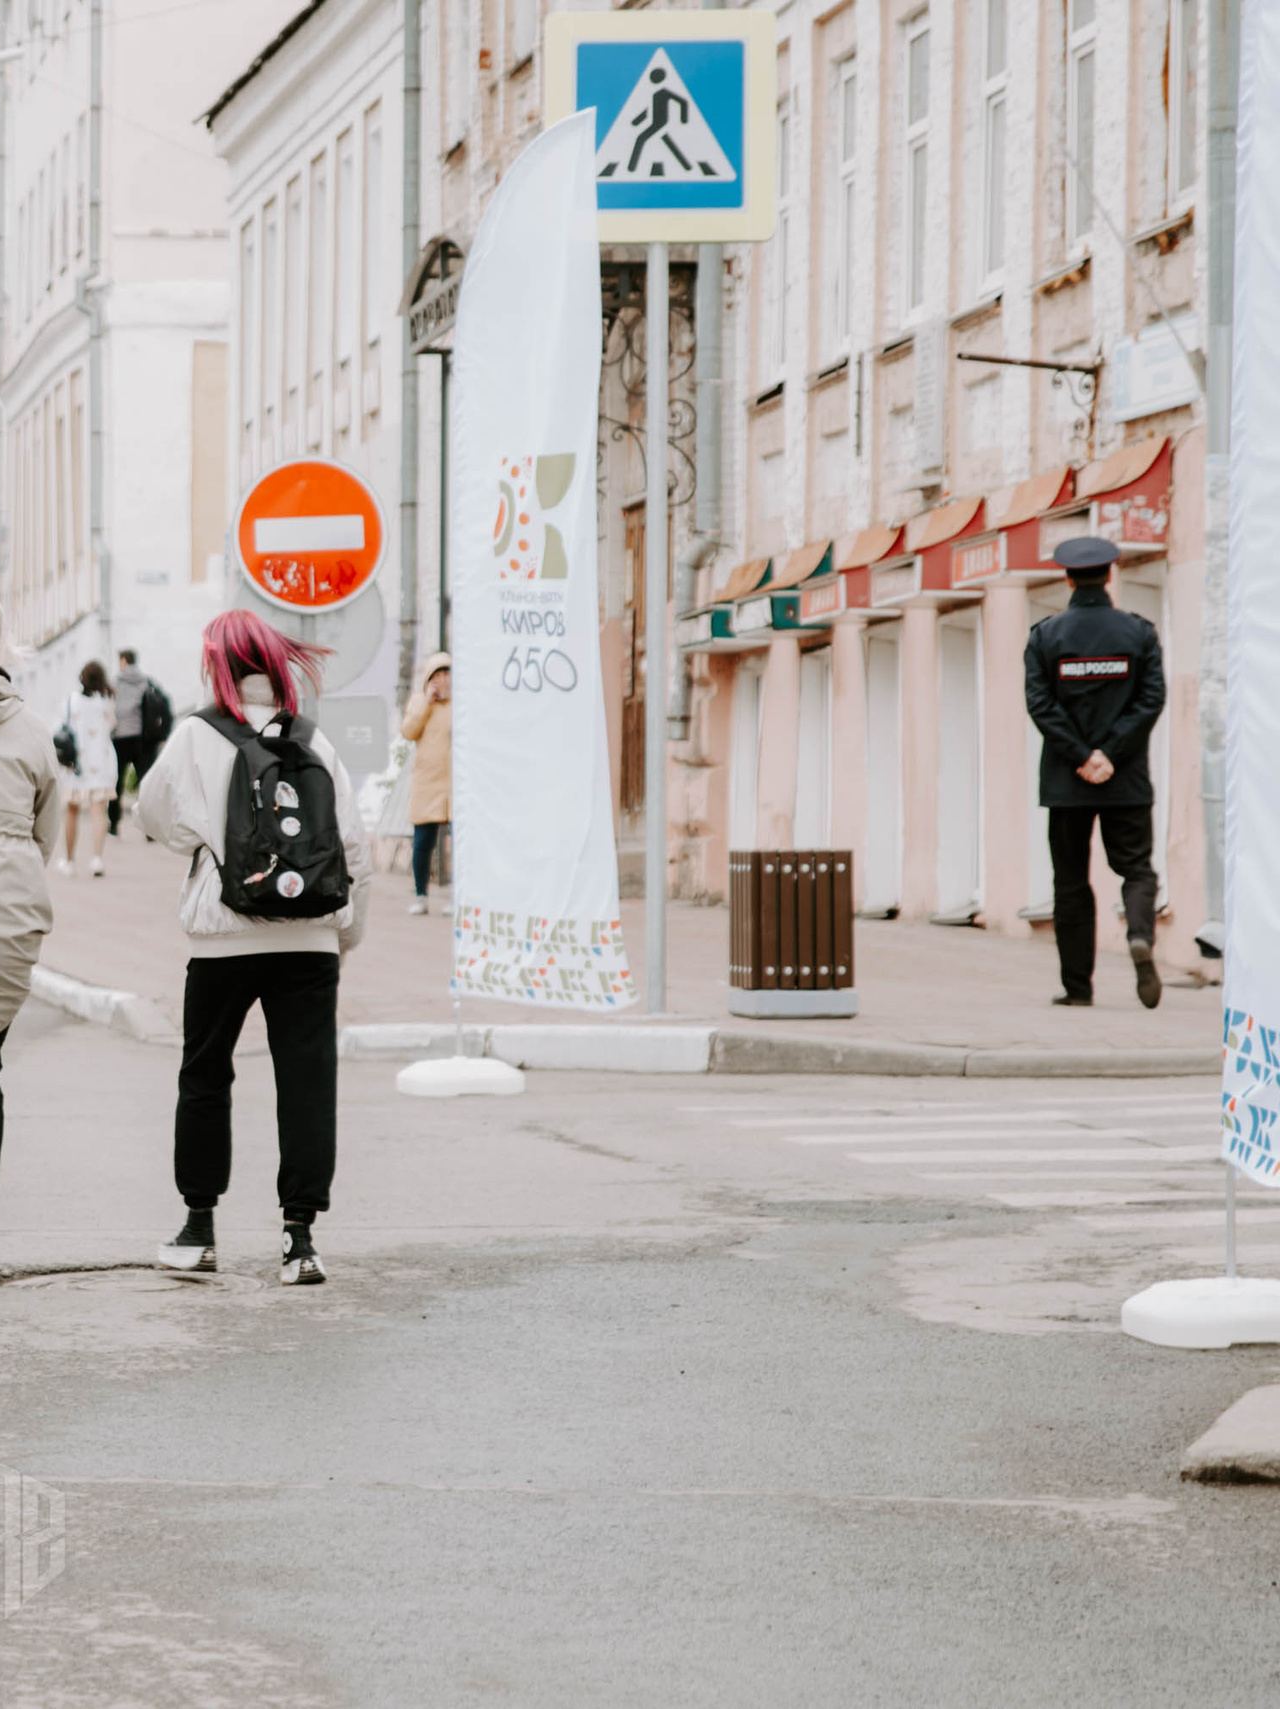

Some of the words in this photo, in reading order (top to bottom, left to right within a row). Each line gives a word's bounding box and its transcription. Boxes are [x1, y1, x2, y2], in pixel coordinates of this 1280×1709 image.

[501, 608, 566, 637] КИРОВ
[502, 646, 578, 693] 650
[1086, 661, 1128, 675] РОССИИ
